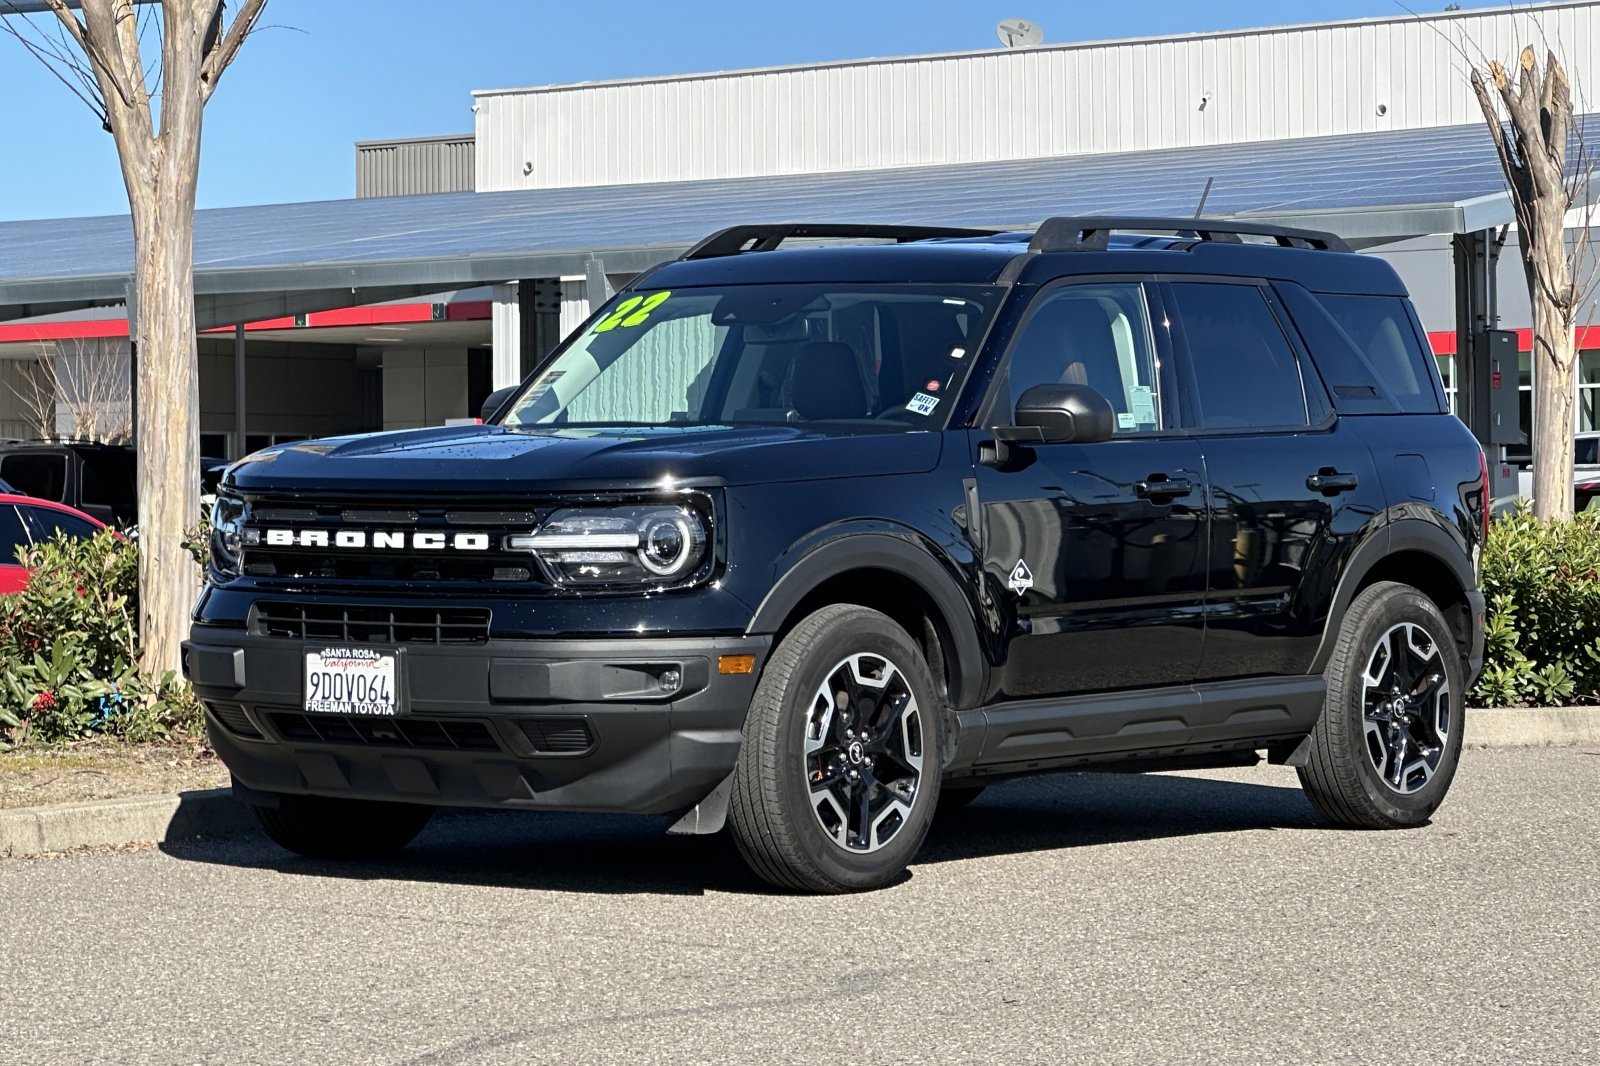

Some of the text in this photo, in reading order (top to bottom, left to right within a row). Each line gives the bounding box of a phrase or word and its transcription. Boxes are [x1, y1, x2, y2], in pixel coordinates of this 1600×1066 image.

[594, 290, 672, 333] 22
[914, 394, 938, 406] SAFETY
[917, 404, 931, 413] OK
[266, 529, 490, 550] BRONCO
[325, 648, 375, 659] SANTA ROSA
[324, 659, 378, 671] California
[305, 700, 394, 715] FREEMAN TOYOTA
